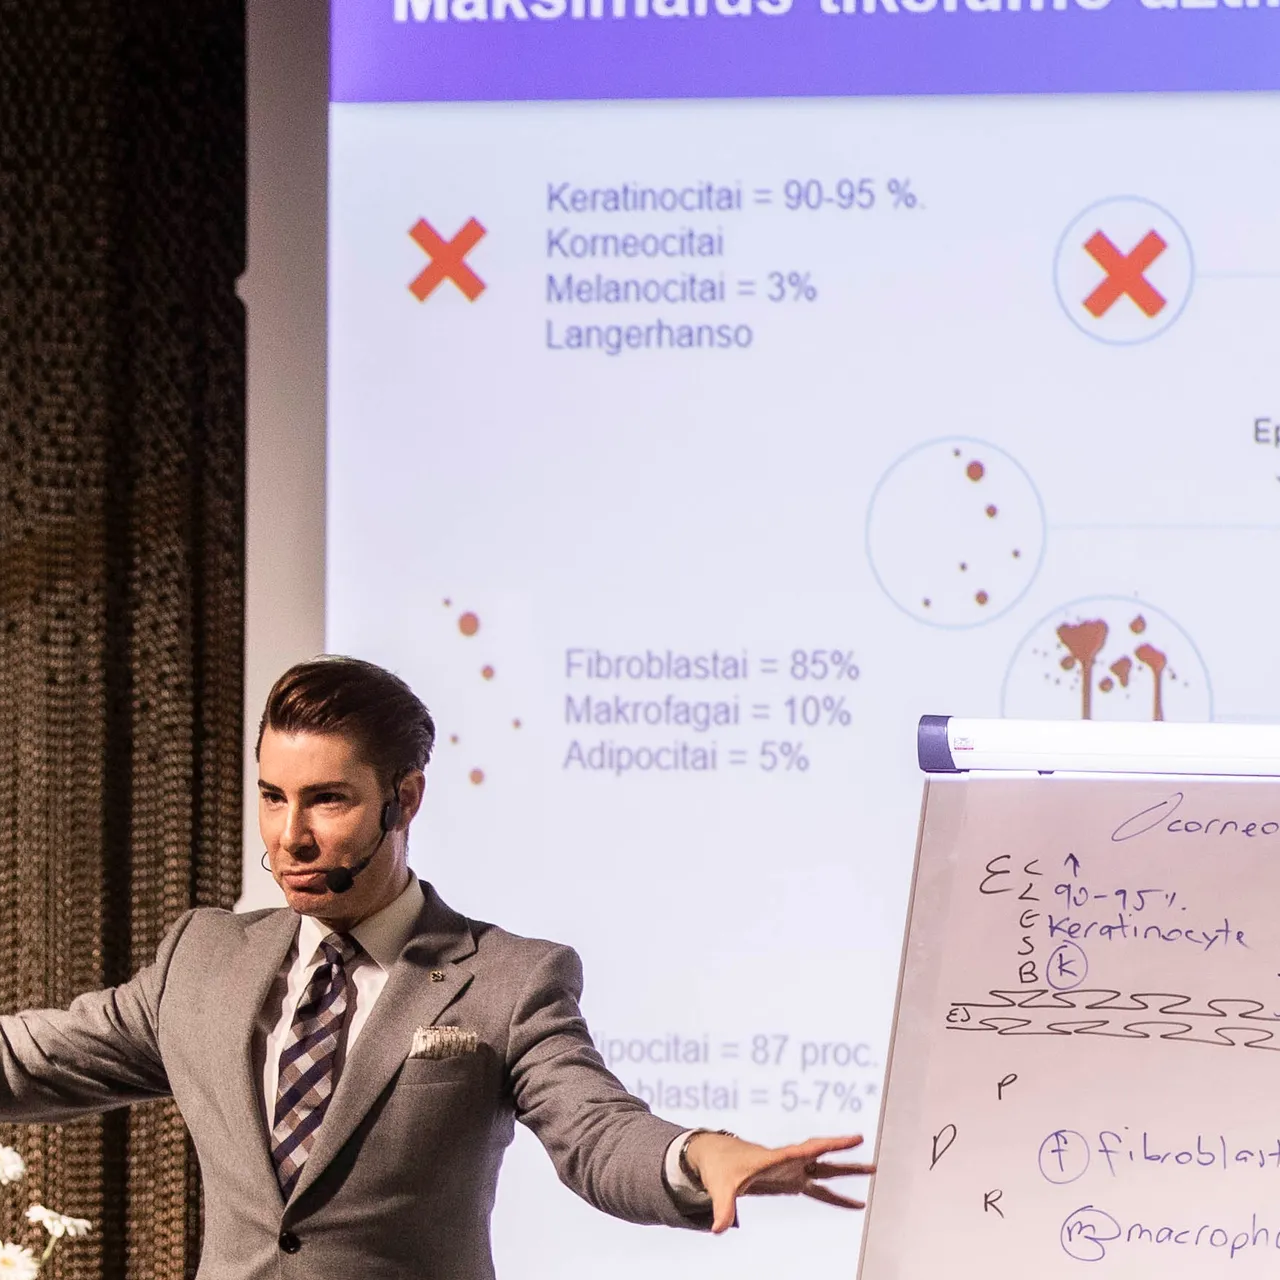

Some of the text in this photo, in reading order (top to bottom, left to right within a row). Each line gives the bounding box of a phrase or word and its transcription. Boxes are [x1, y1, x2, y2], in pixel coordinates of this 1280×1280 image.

[546, 180, 743, 213] Keratinocitai
[753, 189, 772, 206] =
[783, 178, 876, 211] 90-95
[546, 228, 724, 259] Korneocitai
[546, 272, 818, 304] Melanocitai = 3%
[546, 319, 753, 356] Langerhanso
[564, 648, 860, 681] Fibroblastai = 85%
[564, 695, 852, 733] Makrofagai = 10%
[562, 740, 810, 777] Adipocitai = 5%
[1018, 960, 1039, 984] B
[599, 1031, 879, 1074] ipocitai = 87 proc.
[637, 1077, 738, 1112] blastai
[751, 1088, 770, 1104] =
[983, 1188, 1005, 1219] R
